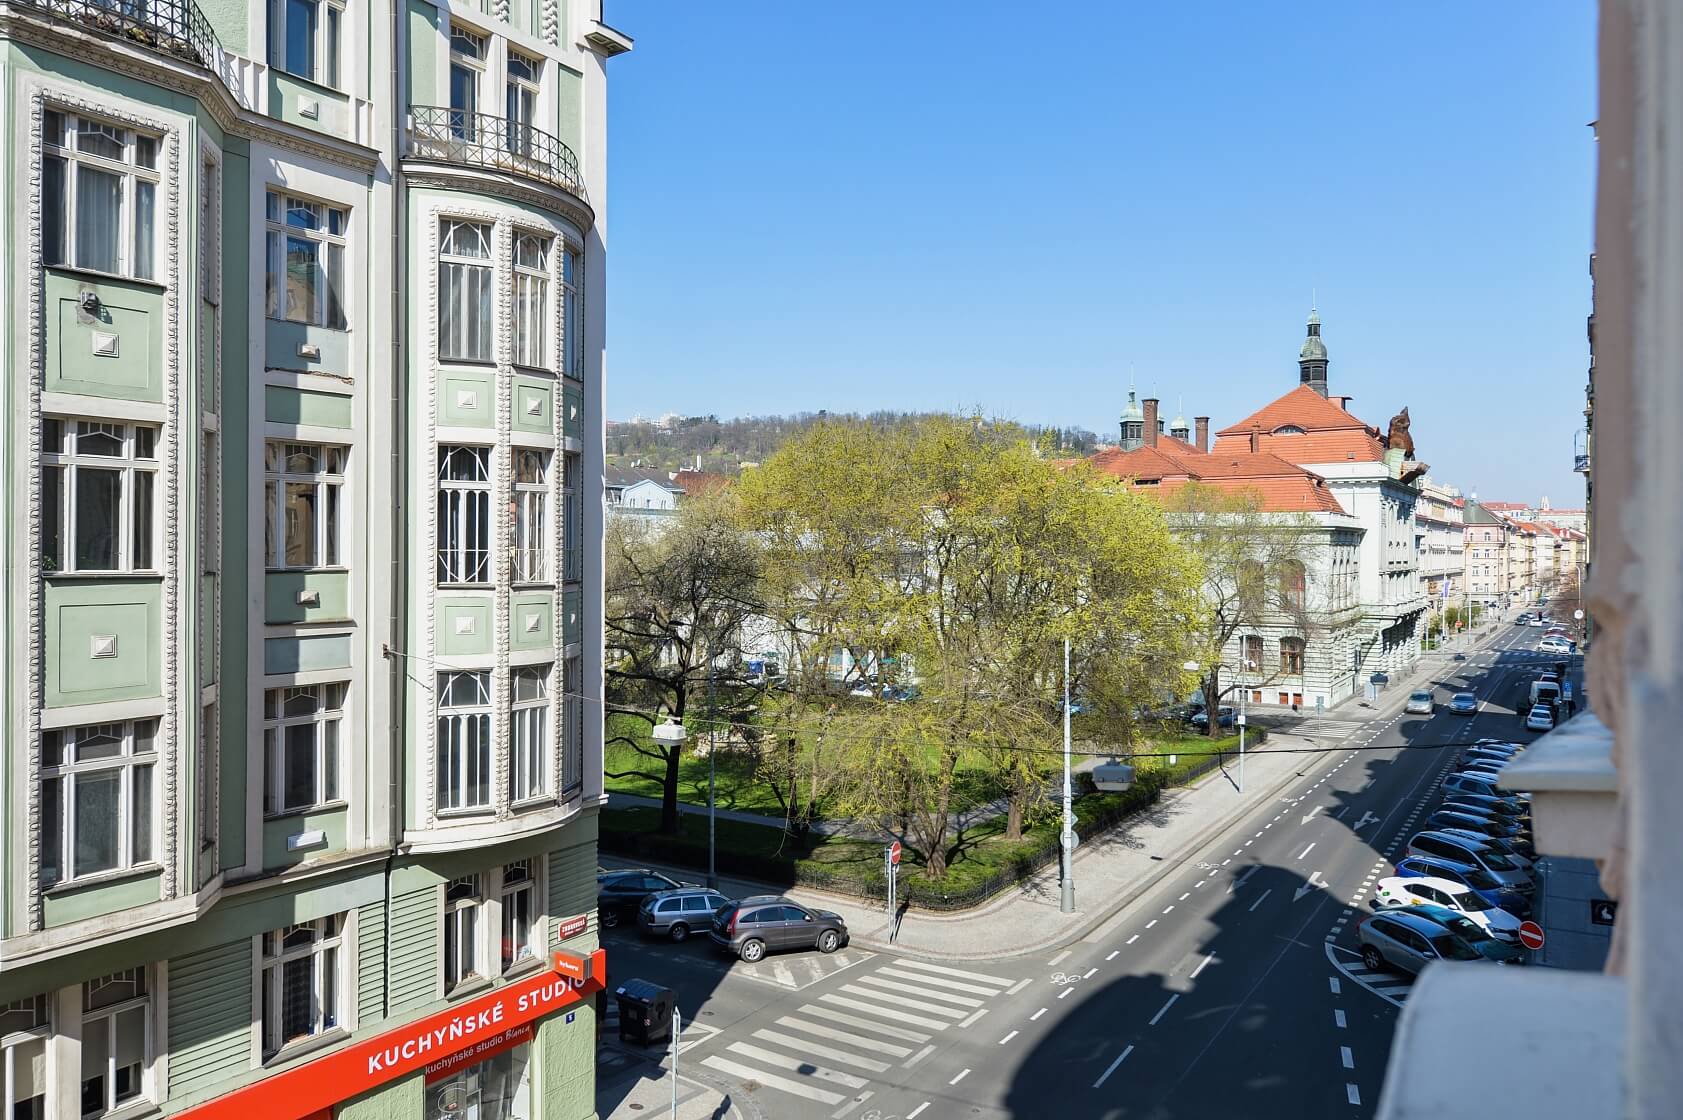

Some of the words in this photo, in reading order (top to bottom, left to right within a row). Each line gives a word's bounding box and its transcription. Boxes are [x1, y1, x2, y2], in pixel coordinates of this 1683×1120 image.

[368, 1001, 504, 1074] KUCHYŇSKÉ
[518, 976, 586, 1012] STUDIO
[425, 1046, 474, 1075] kuchyňské
[476, 1034, 503, 1053] studio
